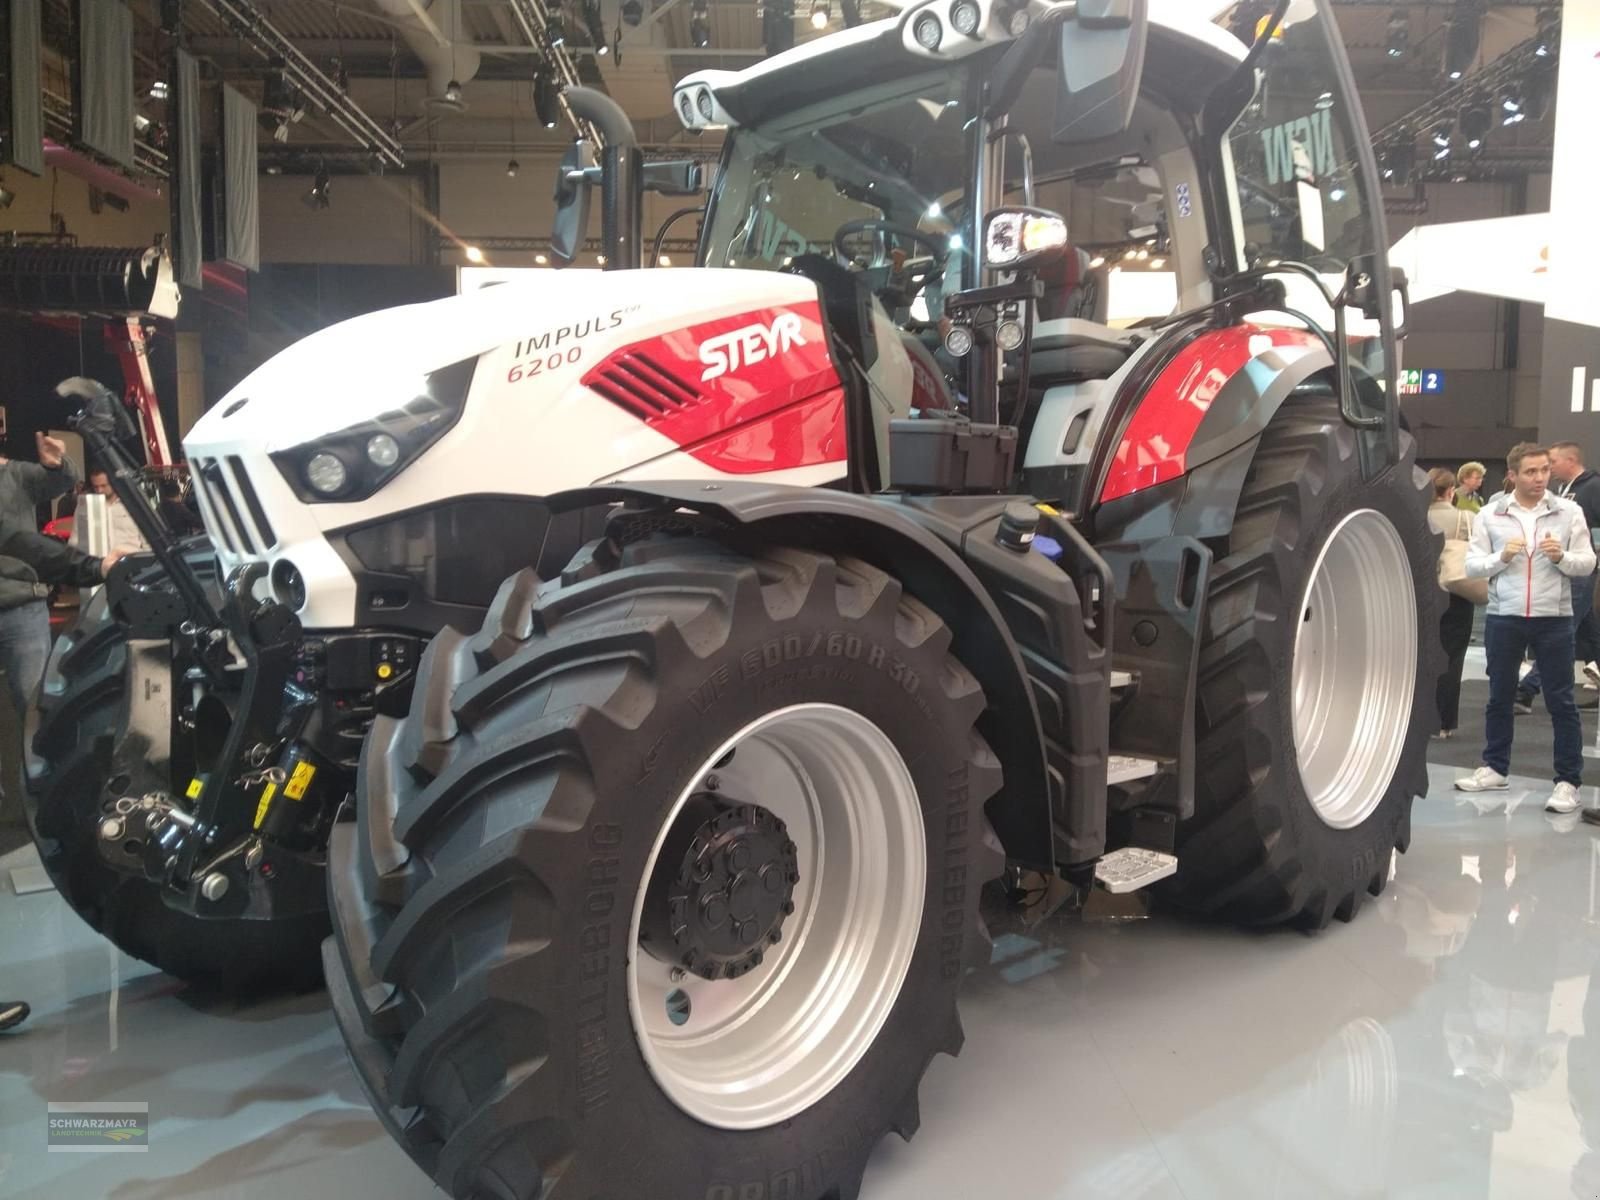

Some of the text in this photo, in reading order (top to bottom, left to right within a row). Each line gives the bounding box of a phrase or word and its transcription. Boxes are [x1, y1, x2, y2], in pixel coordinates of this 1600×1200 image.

[514, 310, 623, 359] IMPULS
[698, 312, 806, 382] STEYR
[507, 346, 582, 383] 6200
[1427, 373, 1437, 389] 2
[888, 655, 921, 695] 30
